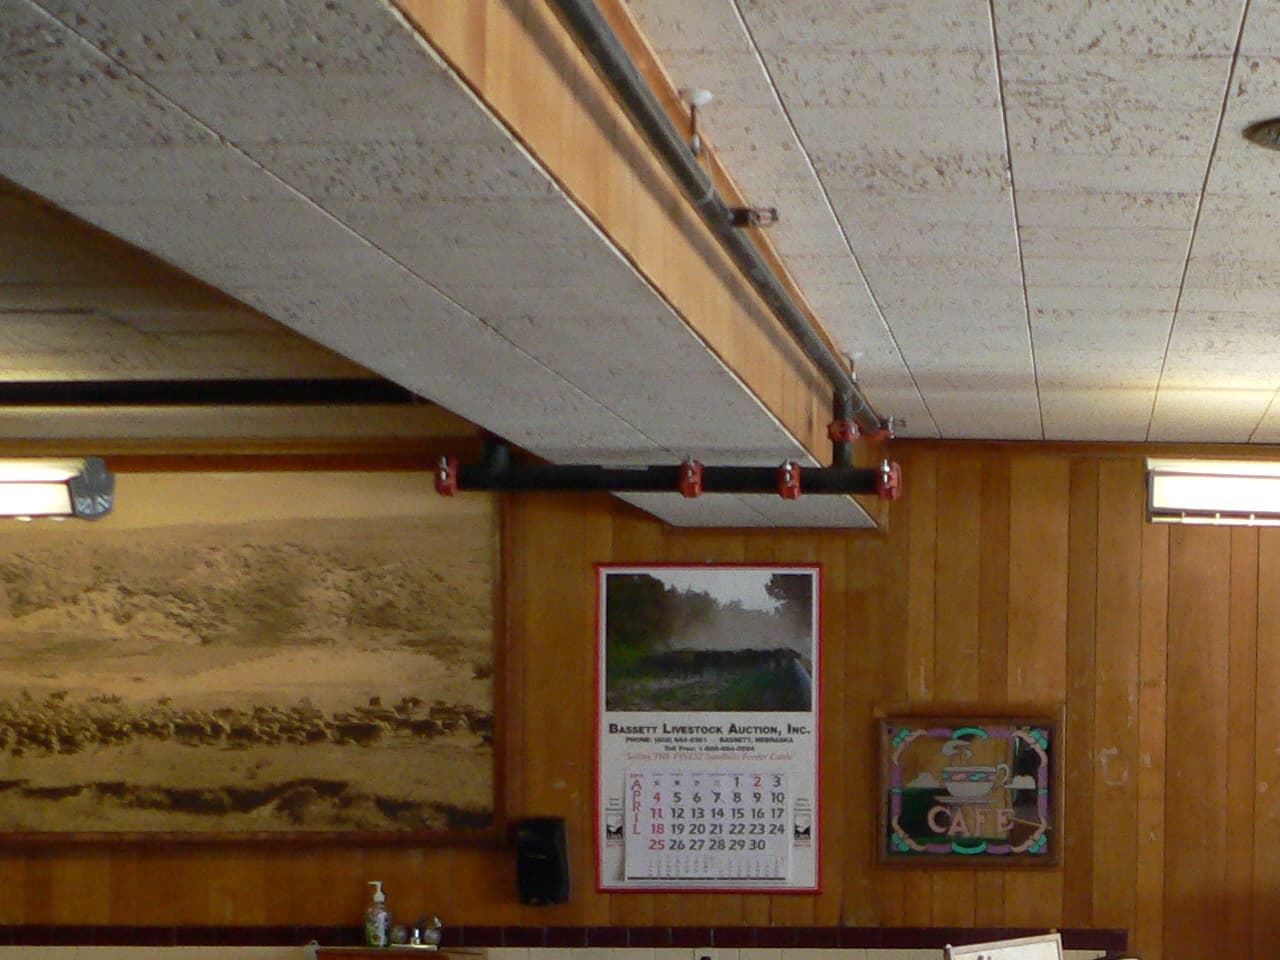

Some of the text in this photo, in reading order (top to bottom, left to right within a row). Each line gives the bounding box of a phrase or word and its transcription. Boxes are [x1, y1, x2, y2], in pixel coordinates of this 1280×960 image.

[735, 776, 781, 787] 1 2 3
[653, 792, 660, 802] 4
[674, 792, 681, 803] 5
[693, 792, 701, 803] 6
[753, 792, 761, 802] 9
[771, 792, 784, 803] 10
[671, 808, 684, 818] 12
[692, 808, 704, 818] 13
[712, 808, 724, 818] 14
[732, 808, 744, 819] 15
[752, 808, 764, 818] 16
[771, 808, 784, 818] 17
[652, 824, 784, 834] 18 19 20 21 22 23 24
[650, 838, 765, 850] 25 26 27 28 29 30
